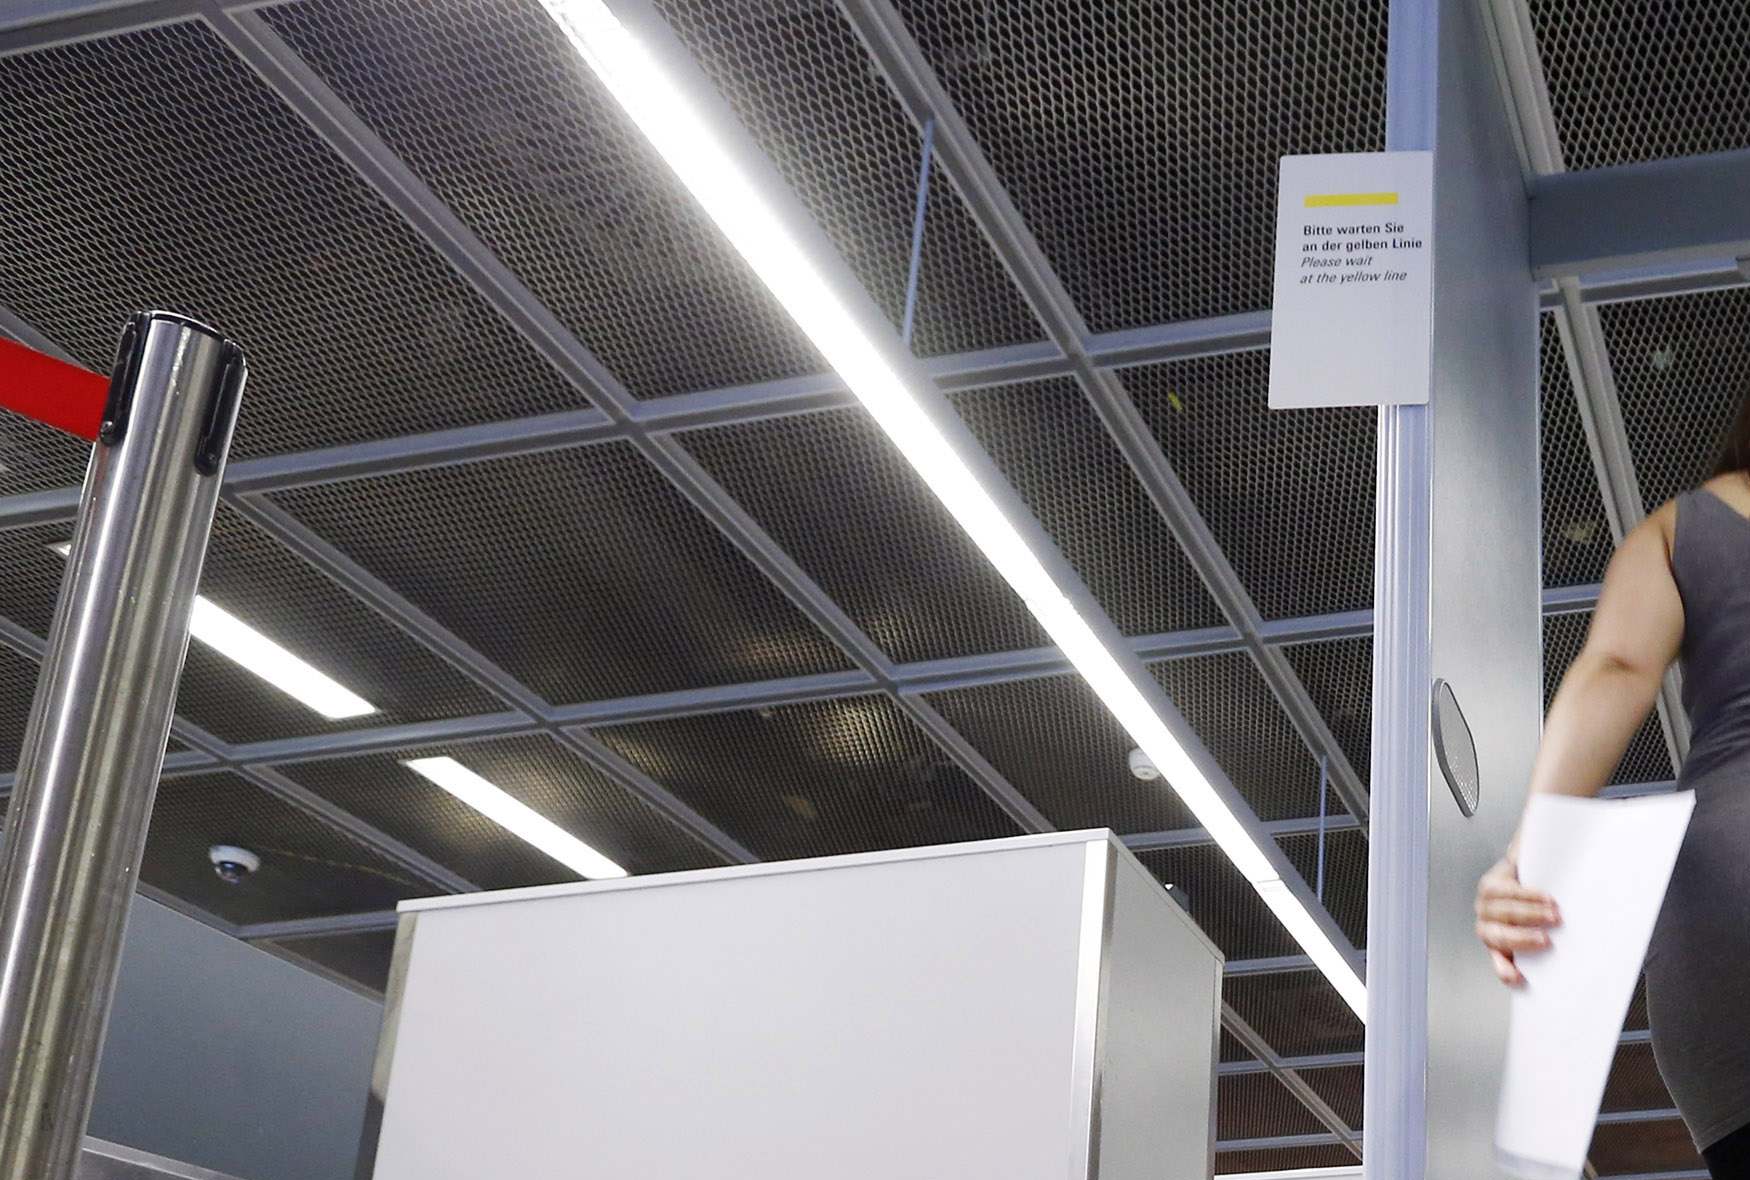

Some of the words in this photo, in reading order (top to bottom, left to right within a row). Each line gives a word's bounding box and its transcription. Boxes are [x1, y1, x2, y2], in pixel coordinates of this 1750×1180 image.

[1303, 224, 1333, 236] Bitte
[1336, 224, 1381, 235] warten
[1384, 222, 1404, 234] Sie
[1302, 243, 1317, 252] an
[1321, 240, 1342, 251] der
[1345, 239, 1388, 252] gelben
[1392, 237, 1422, 249] Linie
[1301, 256, 1342, 268] Please
[1345, 255, 1373, 266] wait
[1300, 274, 1313, 284] at
[1316, 272, 1337, 283] the
[1340, 271, 1381, 284] yellow
[1383, 269, 1407, 281] line
